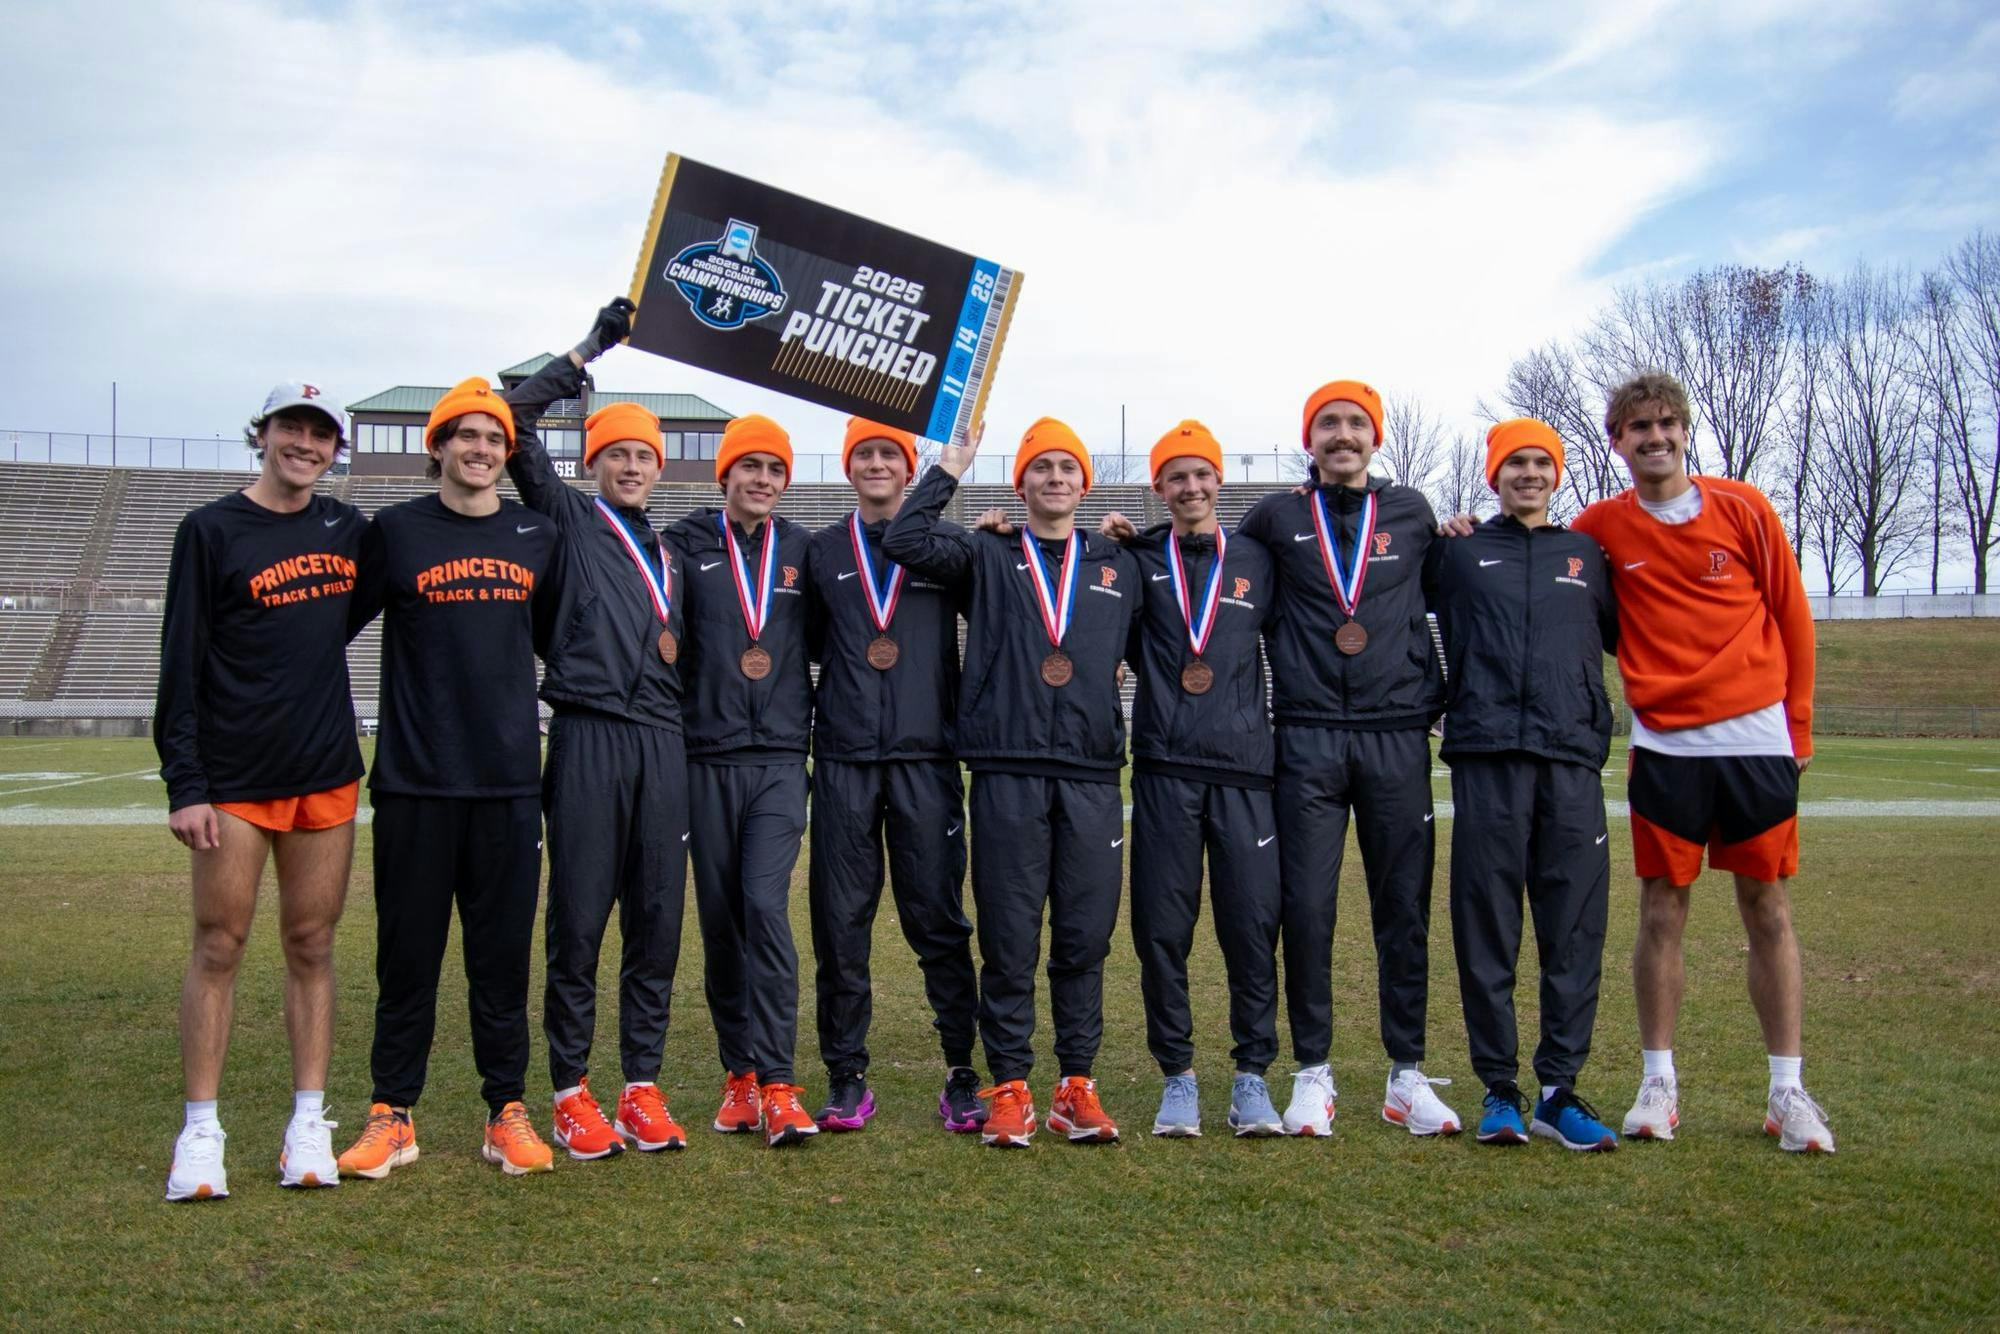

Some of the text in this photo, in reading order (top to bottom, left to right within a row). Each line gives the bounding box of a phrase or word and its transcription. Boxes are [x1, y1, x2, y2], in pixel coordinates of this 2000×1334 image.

[692, 258, 768, 288] CROSS COUNTRY
[708, 254, 740, 271] 2025
[668, 262, 783, 309] CHAMPIONSHIPS
[852, 265, 925, 304] 2025
[815, 280, 931, 344] TICKET
[942, 374, 964, 398] 11
[955, 325, 978, 354] 14
[970, 269, 994, 304] 25
[780, 310, 937, 385] PUNCHED
[301, 384, 321, 399] P
[552, 460, 577, 477] GH
[1374, 532, 1391, 554] P
[1567, 556, 1584, 577] P
[1709, 551, 1728, 572] P
[250, 553, 357, 599] PRINCETON
[416, 557, 534, 593] PRINCETON
[783, 566, 798, 587] P
[1101, 566, 1117, 587] P
[261, 580, 354, 608] TRACK & FIELD
[426, 588, 528, 603] TRACK & FIELD
[1234, 577, 1250, 599] P
